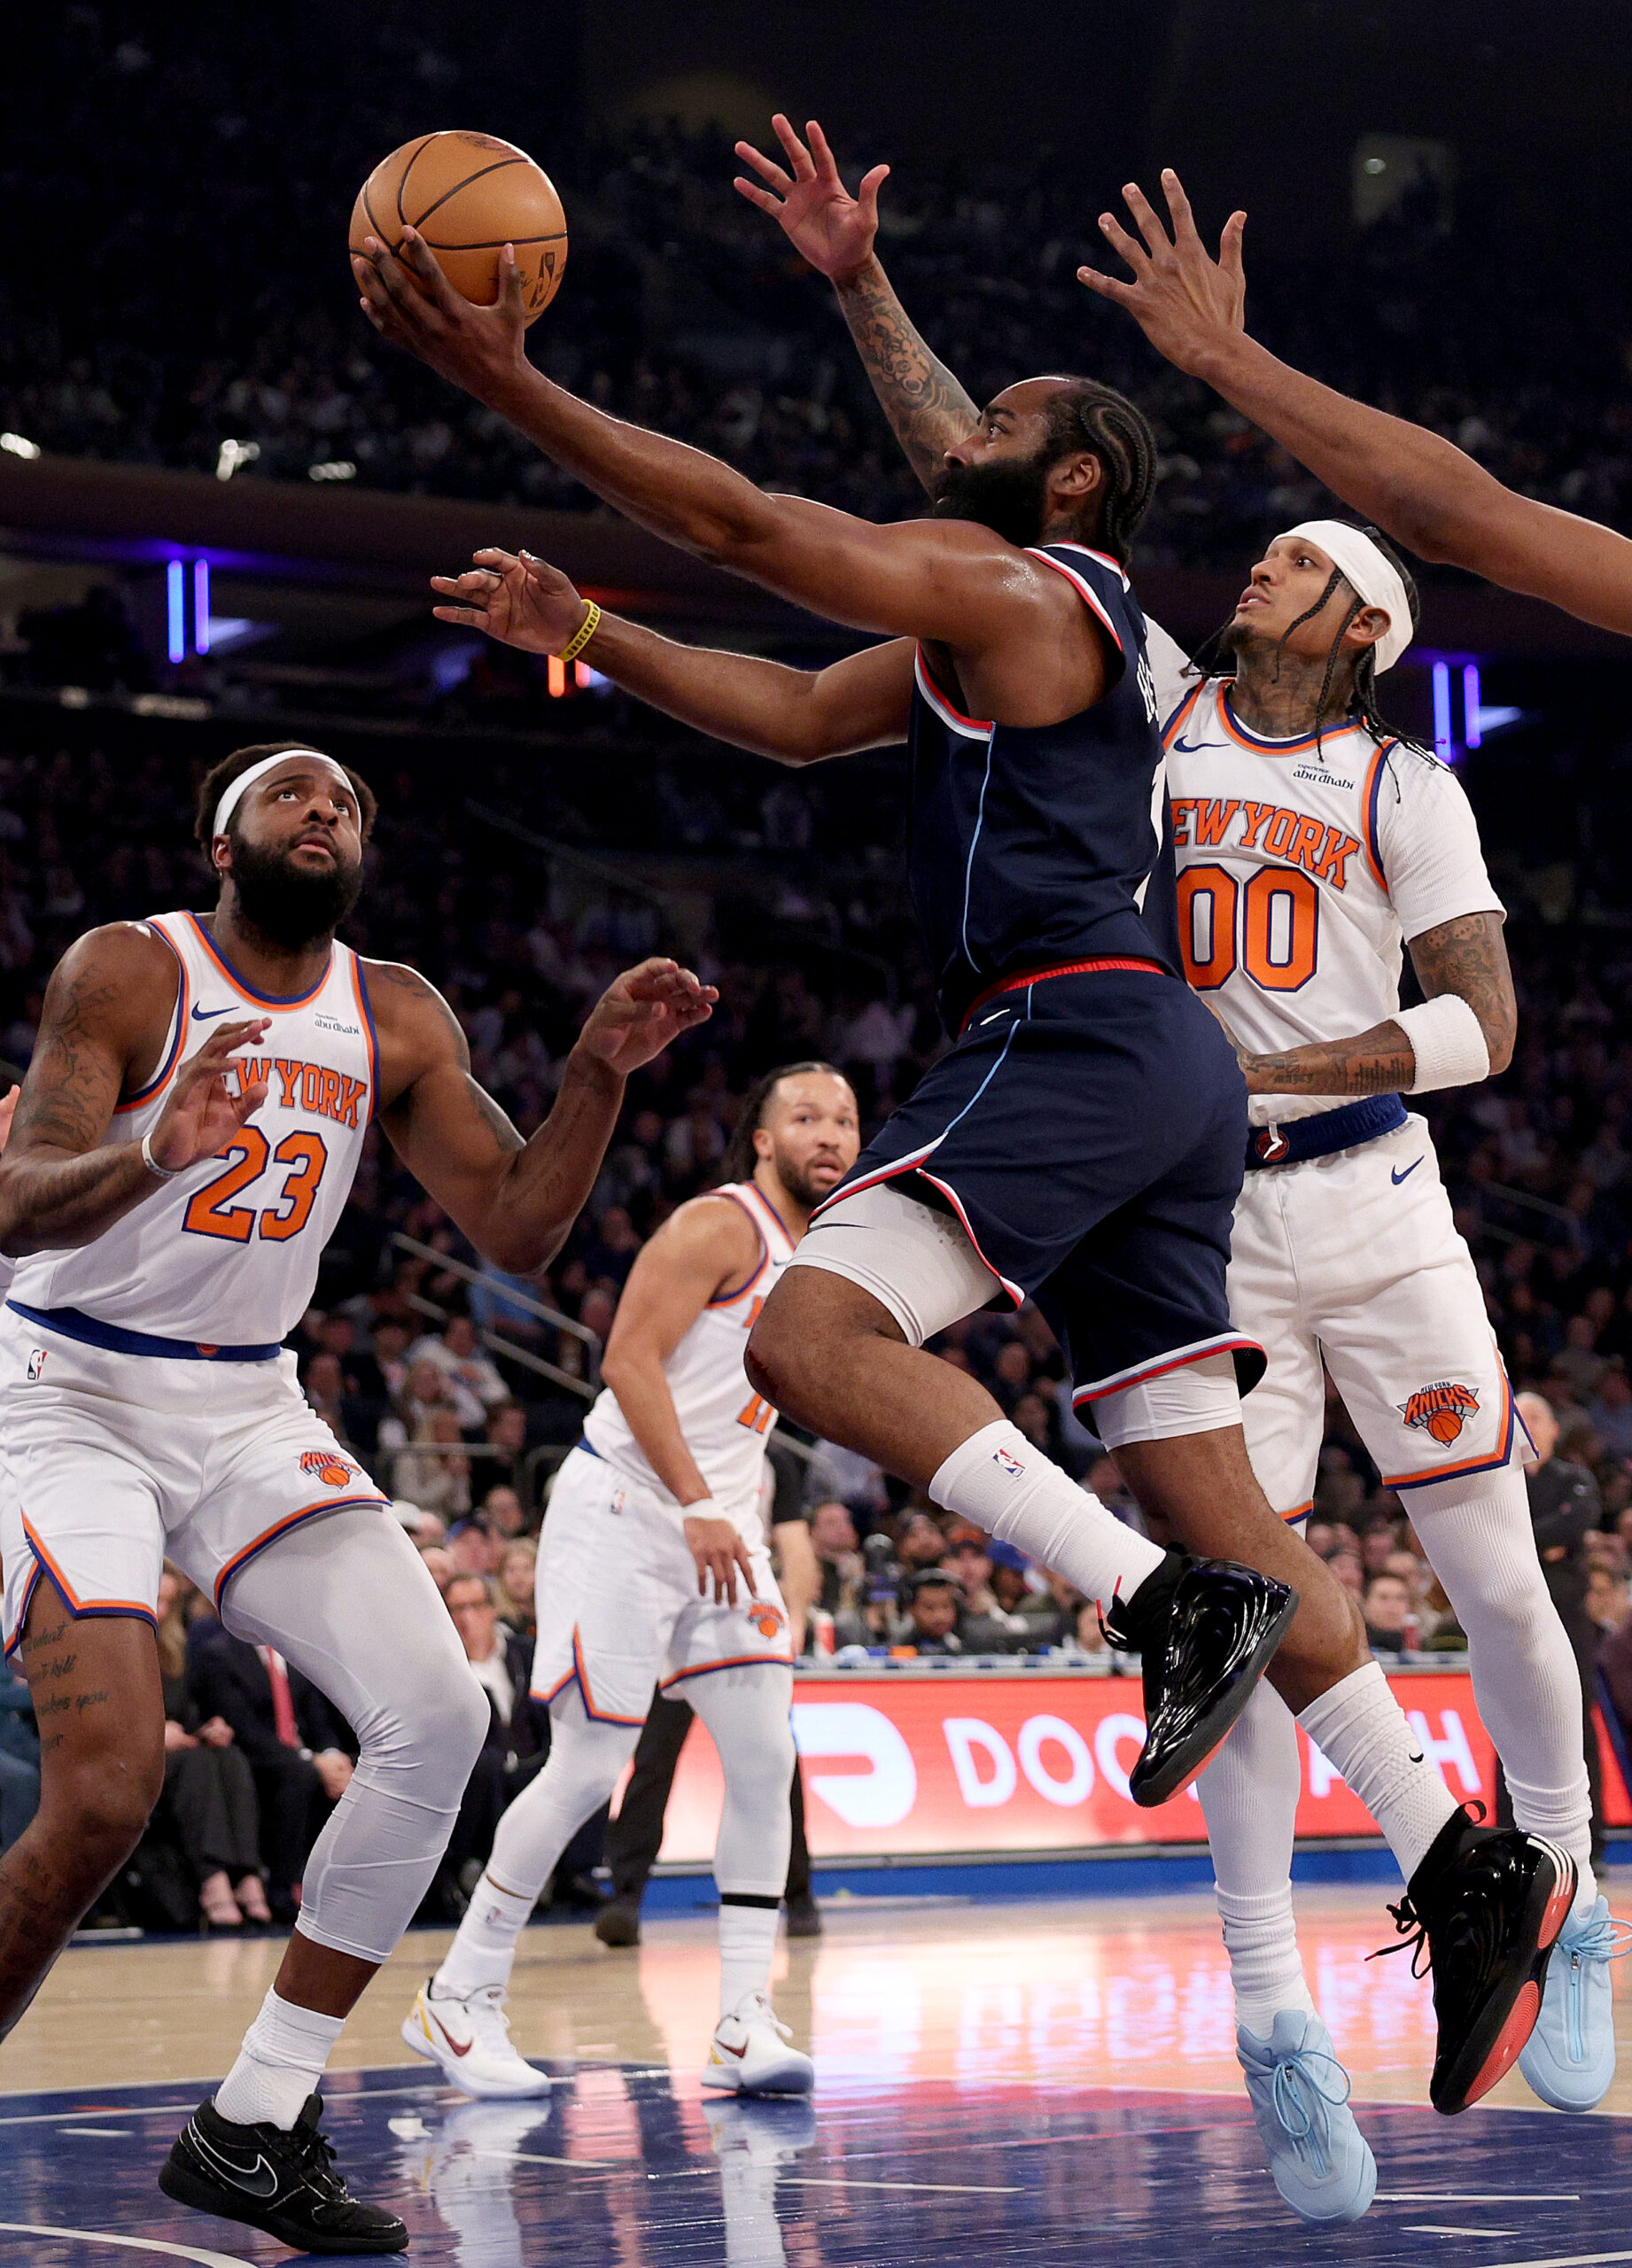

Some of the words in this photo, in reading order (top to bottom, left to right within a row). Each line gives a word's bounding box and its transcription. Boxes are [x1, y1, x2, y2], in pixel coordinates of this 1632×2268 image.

[1293, 770, 1317, 781] abu
[1318, 774, 1356, 789] dhabi
[1170, 798, 1241, 848] EW
[1239, 801, 1361, 893] YORK
[1177, 863, 1319, 992] 00
[274, 1058, 368, 1130] YORK
[181, 1124, 329, 1245] 23
[1403, 1384, 1480, 1425] KNICKS
